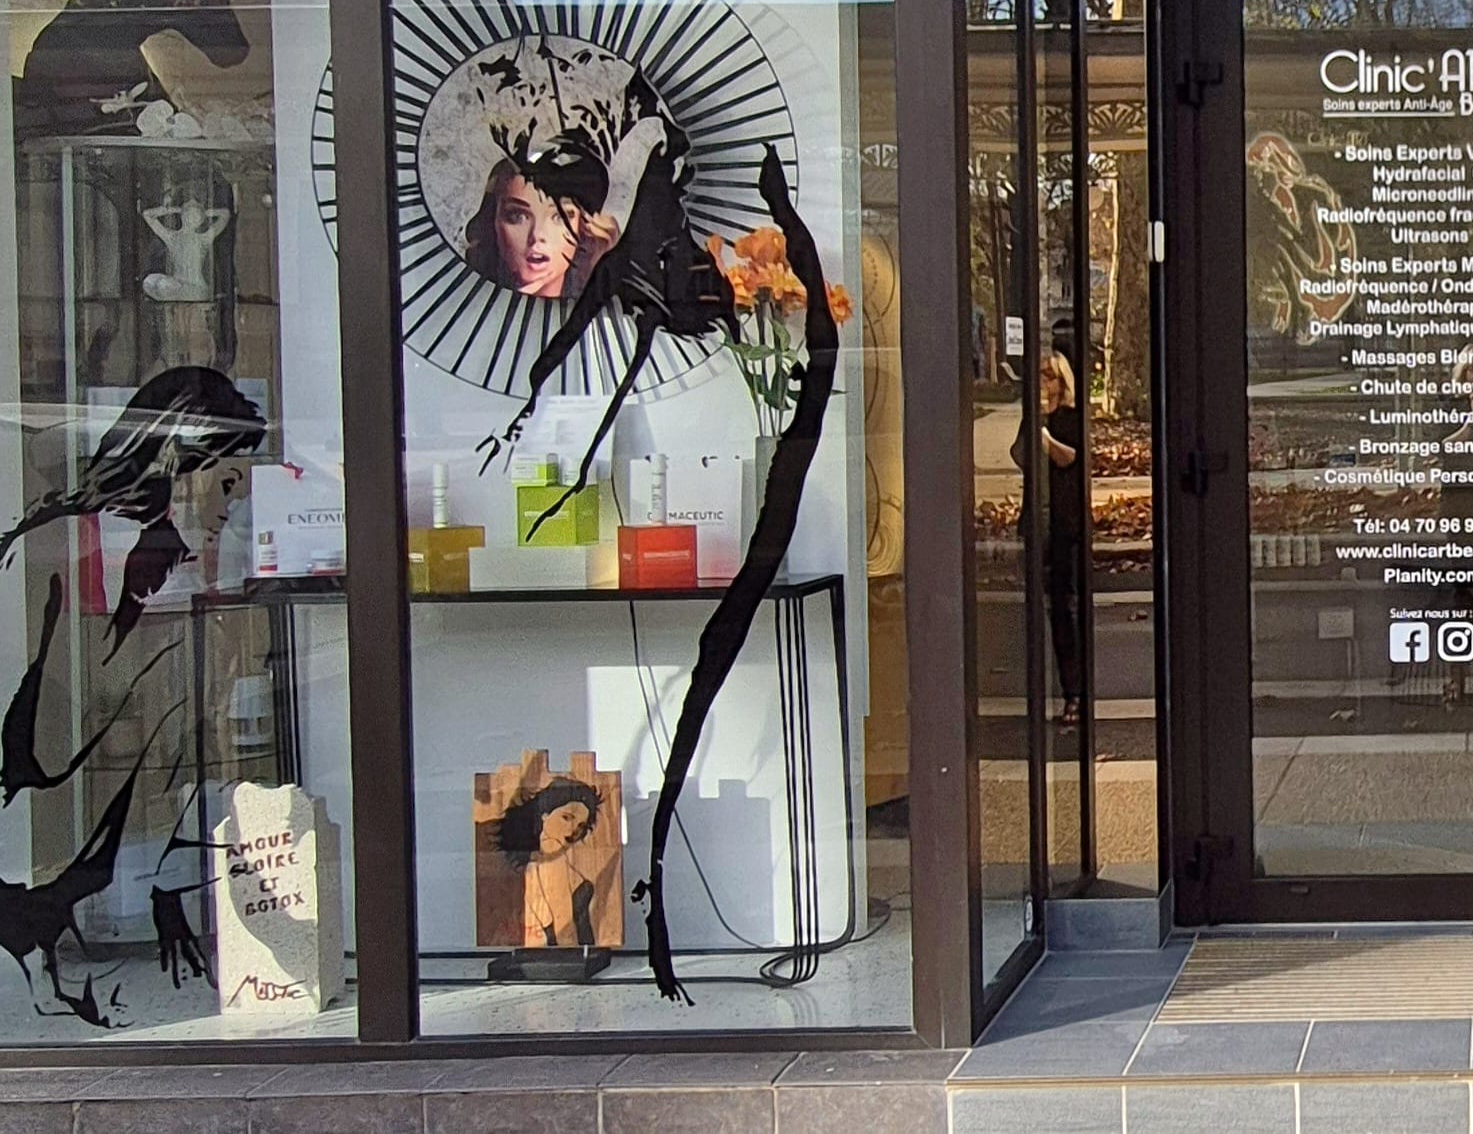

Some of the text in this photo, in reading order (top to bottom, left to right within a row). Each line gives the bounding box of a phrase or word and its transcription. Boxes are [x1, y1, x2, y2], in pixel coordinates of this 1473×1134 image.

[1323, 98, 1355, 111] Soins
[1358, 98, 1401, 113] experts
[1345, 144, 1392, 161] Soins
[1396, 144, 1462, 164] Experts
[1372, 166, 1466, 185] Hydrafacial
[1316, 207, 1447, 227] Radiofréquence
[1391, 228, 1469, 244] Ultrasons
[1340, 257, 1387, 274] Soins
[1391, 257, 1457, 277] Experts
[1299, 277, 1428, 297] Radiofréquence
[1309, 320, 1383, 339] Drainage
[1352, 350, 1437, 367] Massages
[1361, 379, 1413, 395] Chute
[1417, 380, 1438, 395] de
[1360, 439, 1440, 456] Bronzage
[1324, 468, 1426, 486] Cosmétique
[1353, 518, 1385, 534] Tél:
[1389, 518, 1411, 534] 04
[1415, 518, 1436, 534] 70
[1440, 518, 1460, 534] 96
[1389, 607, 1423, 619] Suivez
[1425, 609, 1450, 619] nous
[1451, 609, 1468, 619] sur
[226, 831, 293, 859] AMOUR
[259, 876, 280, 893] ET
[245, 890, 305, 917] BOTOX
